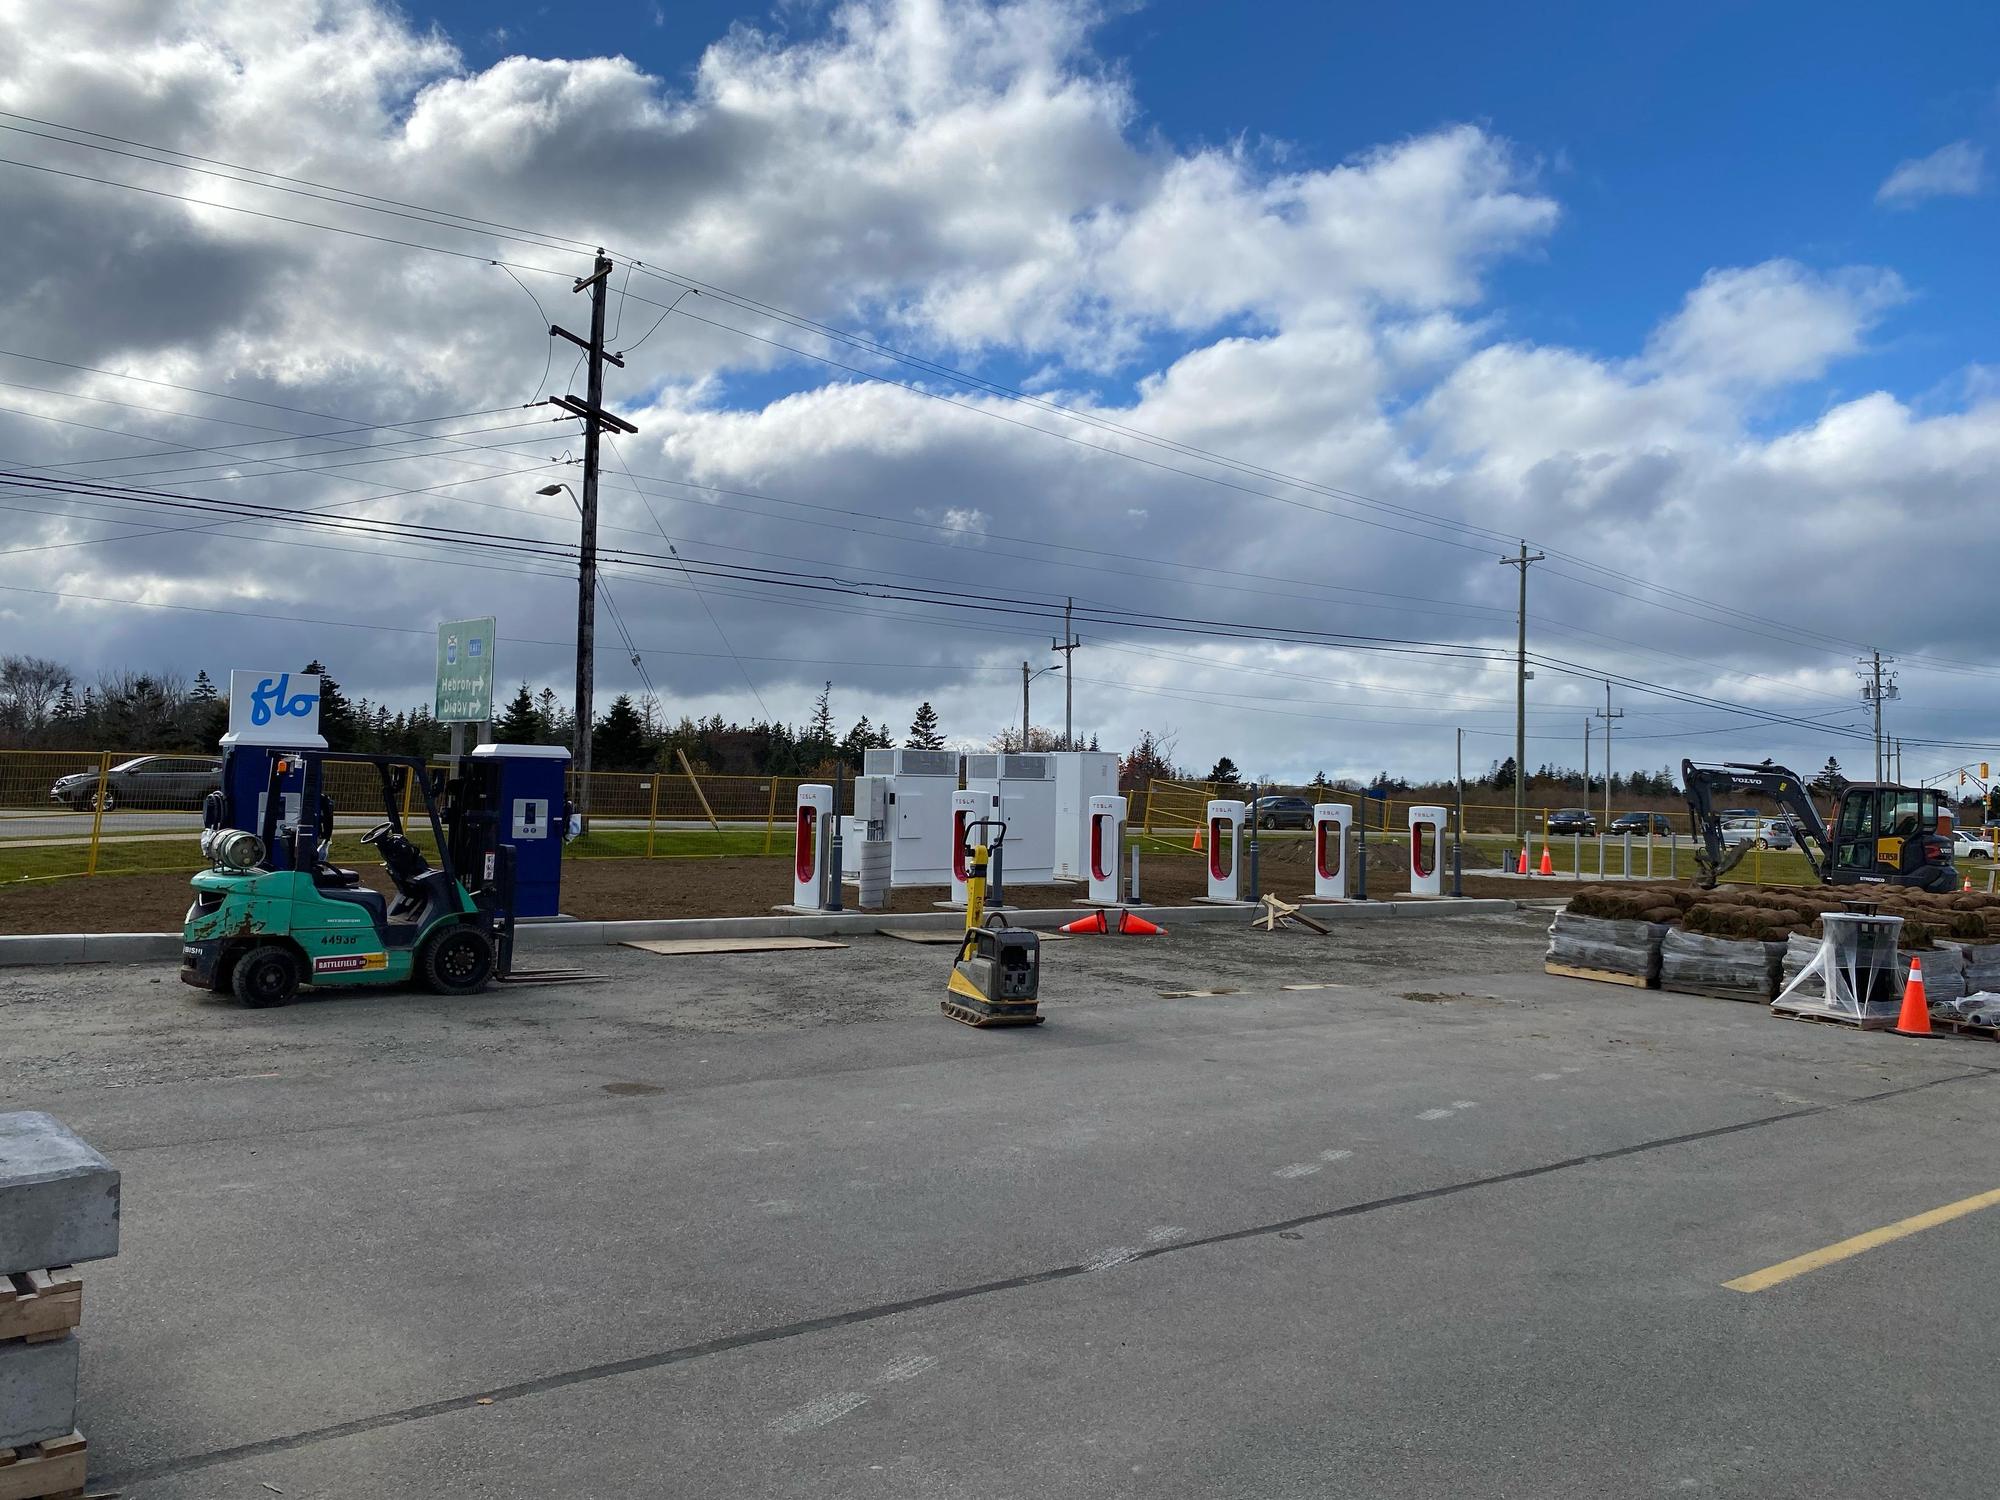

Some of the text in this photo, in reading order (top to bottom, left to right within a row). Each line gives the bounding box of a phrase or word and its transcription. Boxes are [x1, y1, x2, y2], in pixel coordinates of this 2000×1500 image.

[441, 678, 471, 691] Hebron
[250, 673, 320, 726] flo
[443, 699, 467, 717] Digby
[318, 960, 357, 969] BATTLEFIELD
